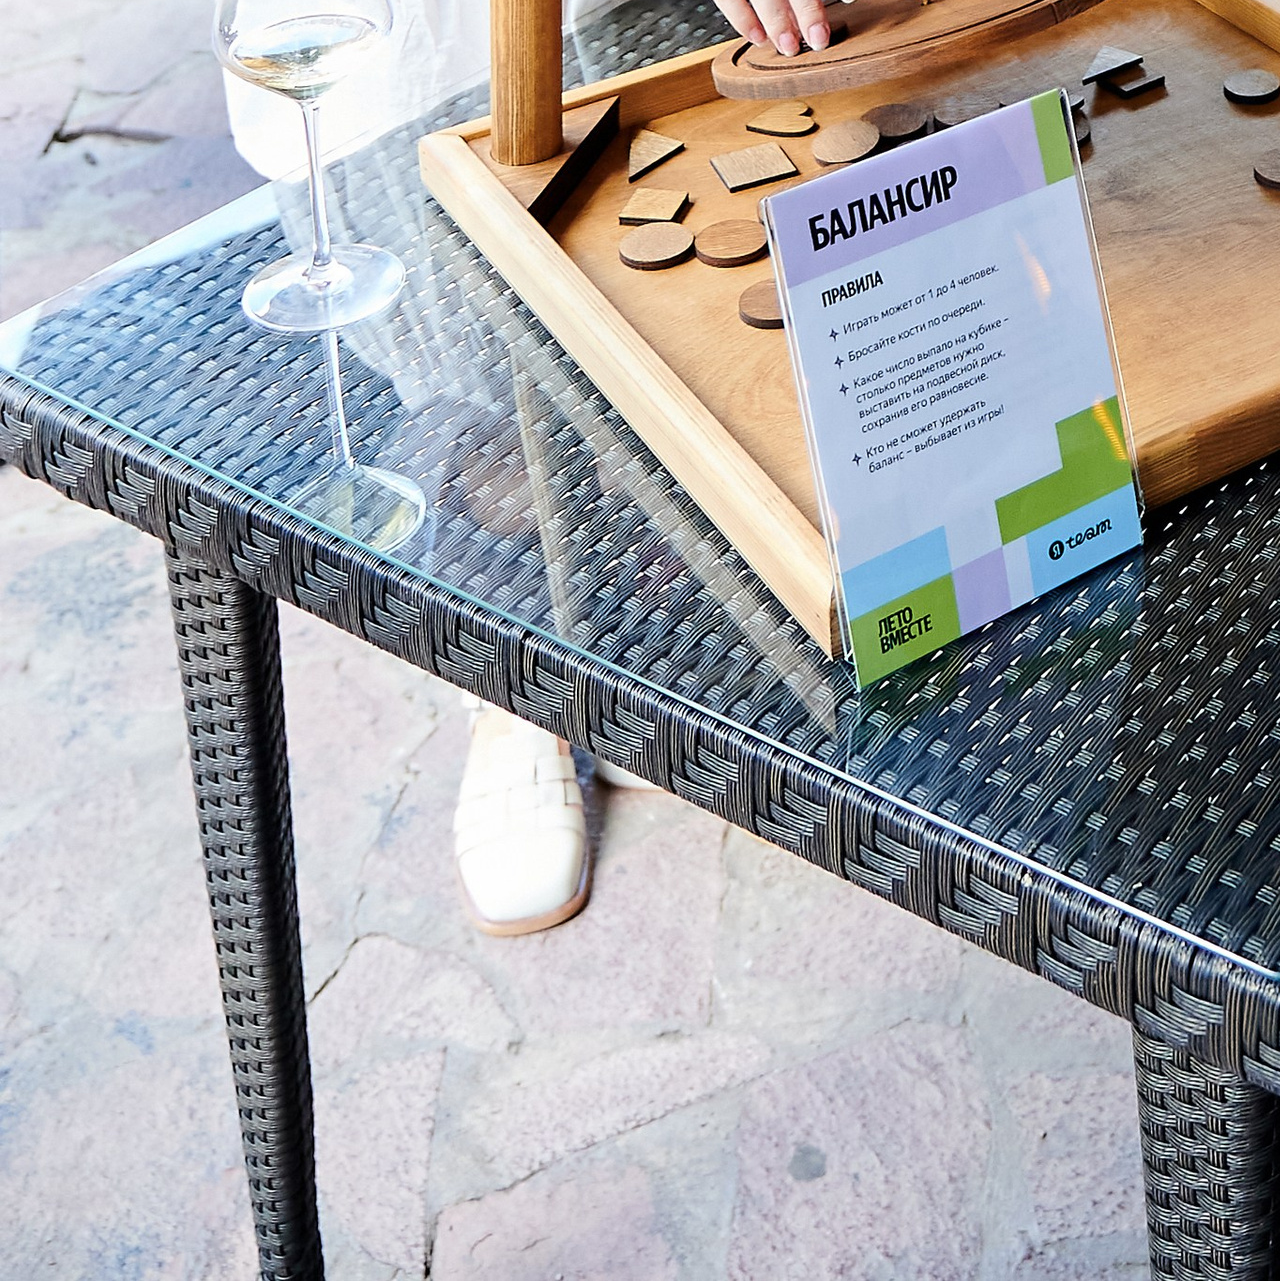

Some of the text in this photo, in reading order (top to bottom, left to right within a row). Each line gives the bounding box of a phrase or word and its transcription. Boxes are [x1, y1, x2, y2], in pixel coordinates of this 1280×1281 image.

[807, 165, 958, 252] БАЛАНСИР
[820, 270, 884, 308] ПРАВИЛА
[843, 264, 1000, 335] Играть может от 1 до 4 человек.
[848, 298, 986, 363] Бросайте кости по очереди.
[853, 369, 884, 389] Какое
[885, 356, 916, 375] число
[917, 340, 954, 362] выпало
[954, 332, 967, 345] на
[968, 318, 1002, 342] кубике
[856, 341, 985, 404] столько предметов нужно
[858, 391, 912, 419] выставить
[913, 383, 925, 395] на
[926, 359, 979, 390] подвесной
[861, 371, 989, 434] сохранив его равновесие.
[865, 399, 987, 459] Кто не сможет удержать
[868, 450, 905, 474] баланс
[914, 423, 962, 454] выбывает
[964, 417, 976, 430] из
[977, 404, 1005, 424] игры!
[1064, 518, 1113, 549] team
[877, 606, 914, 638] ЛЕТО
[880, 613, 933, 654] ВМЕСТЕ
